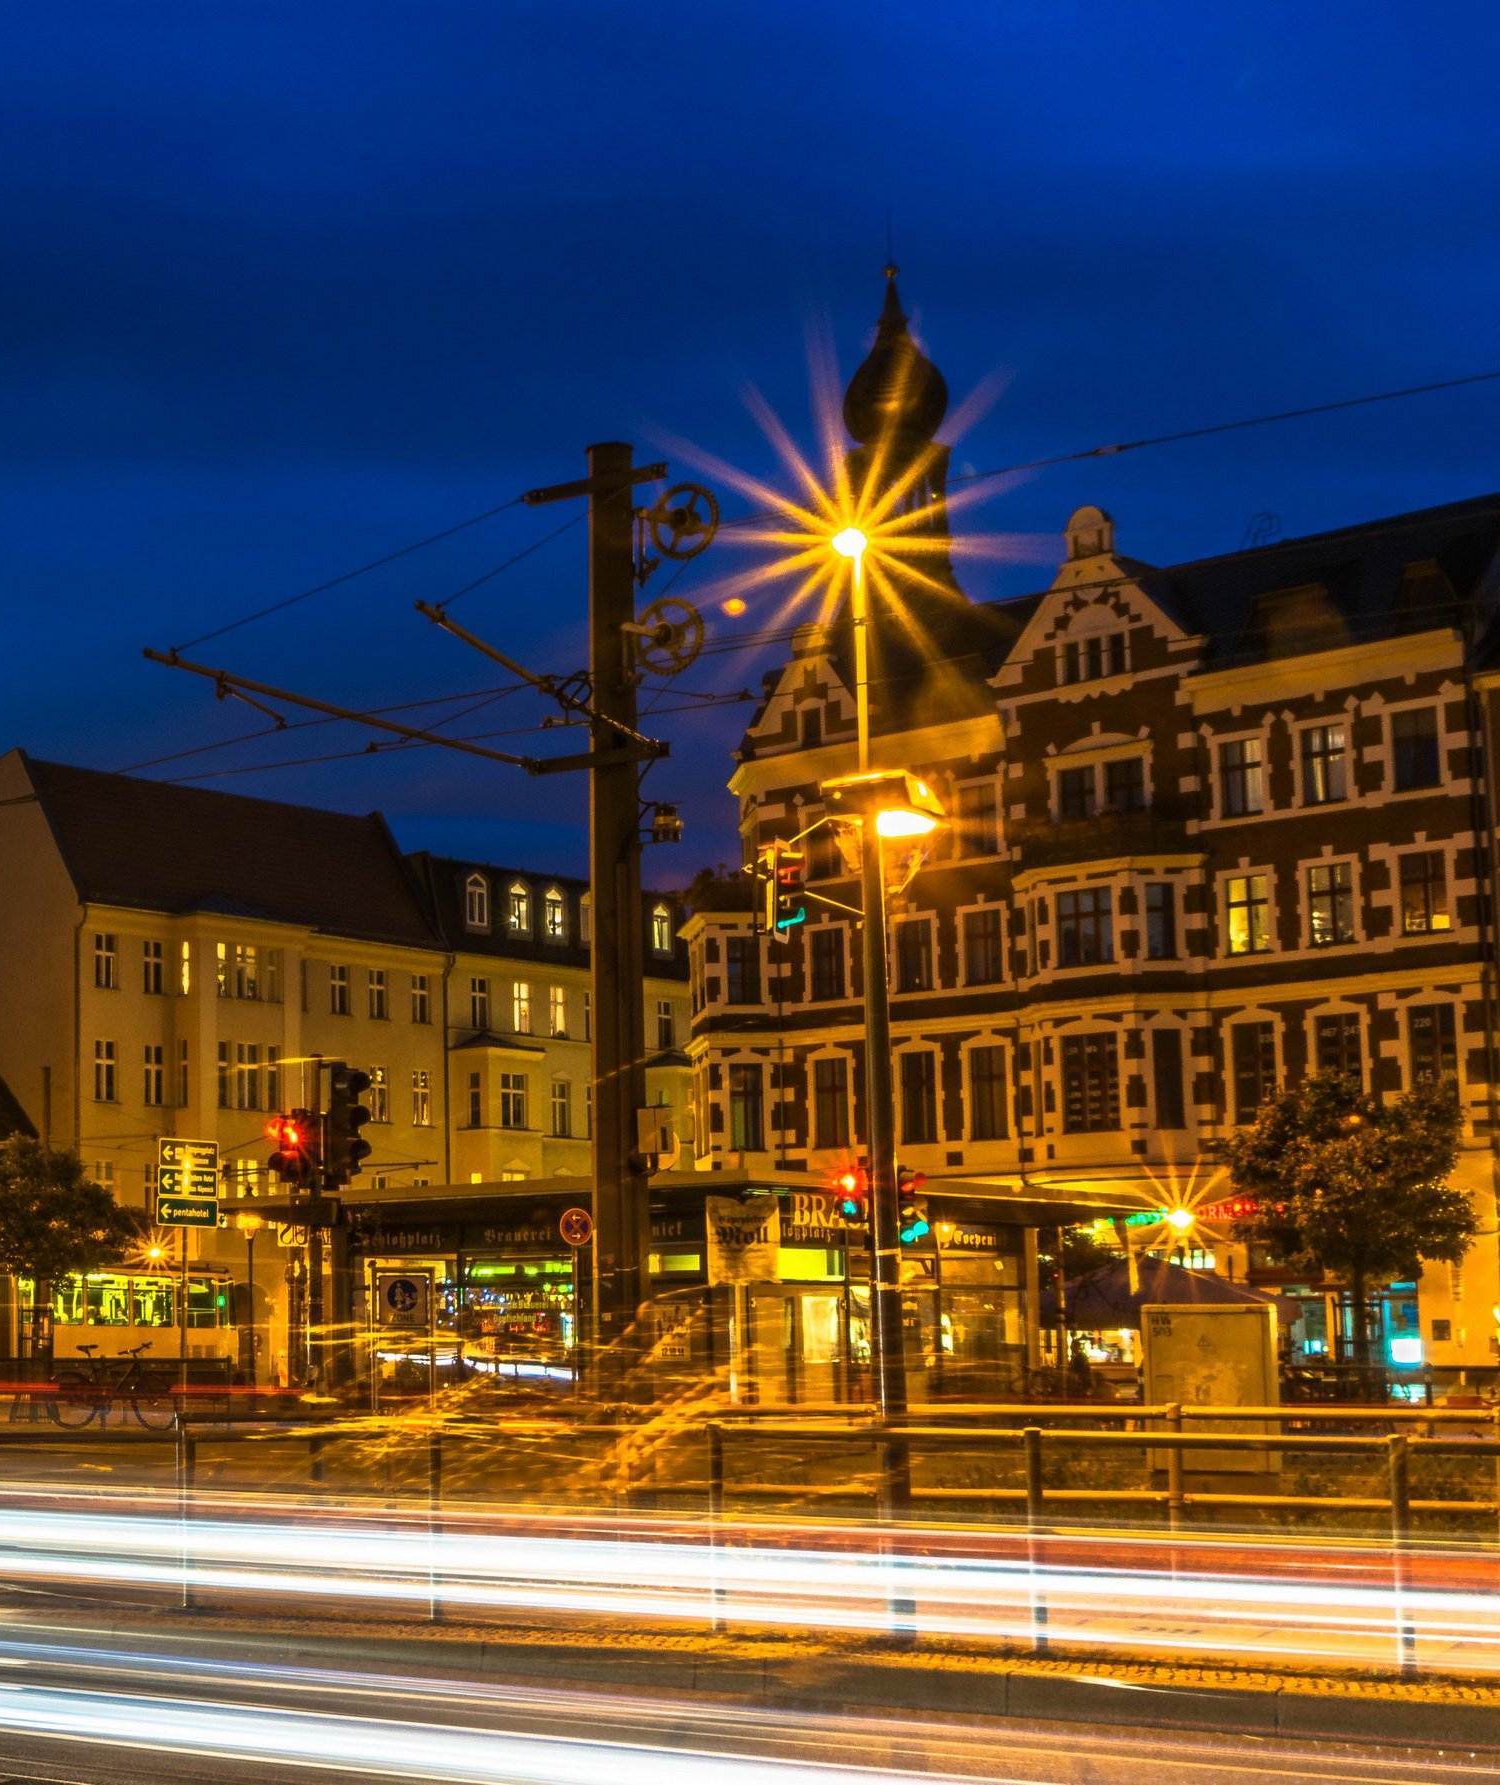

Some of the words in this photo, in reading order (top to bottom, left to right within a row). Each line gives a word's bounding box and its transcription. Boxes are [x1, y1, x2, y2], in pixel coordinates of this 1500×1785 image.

[173, 1207, 209, 1218] pentahotel
[483, 1227, 552, 1243] Brauerei
[390, 1313, 415, 1323] ZONE
